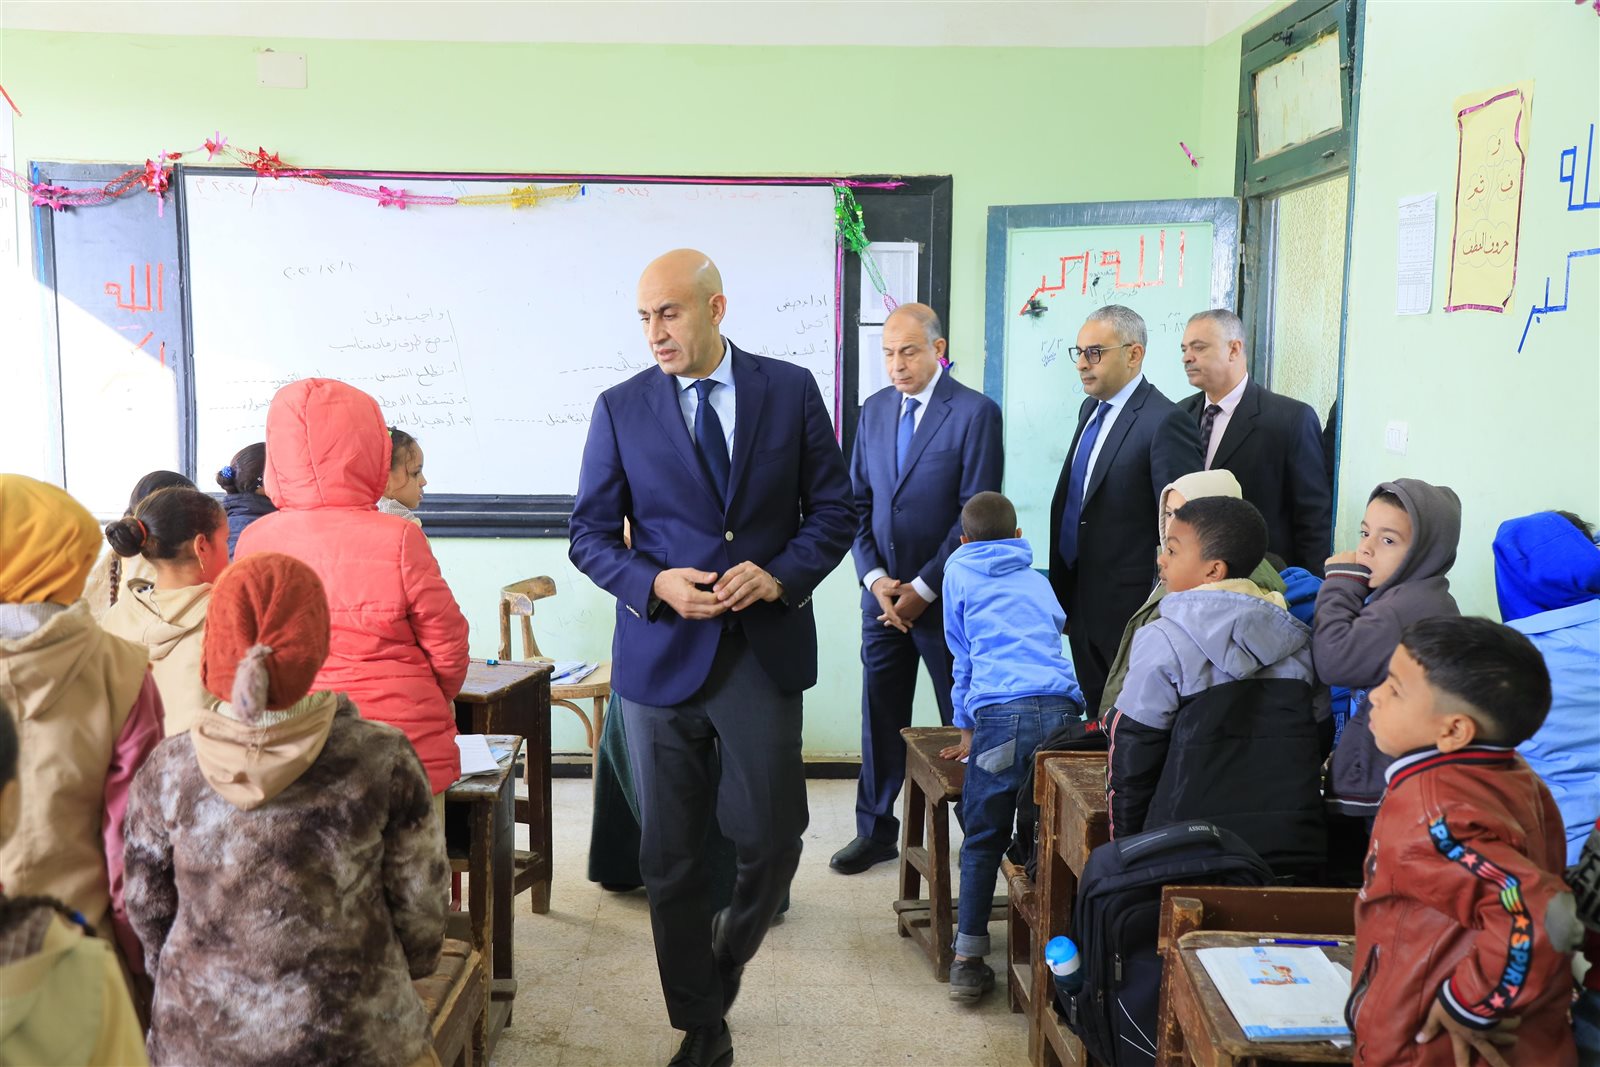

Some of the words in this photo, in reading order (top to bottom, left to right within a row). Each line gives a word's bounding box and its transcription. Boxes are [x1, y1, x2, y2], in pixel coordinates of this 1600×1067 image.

[1500, 173, 1514, 193] ف
[1484, 235, 1510, 255] حروف
[103, 262, 164, 312] الله
